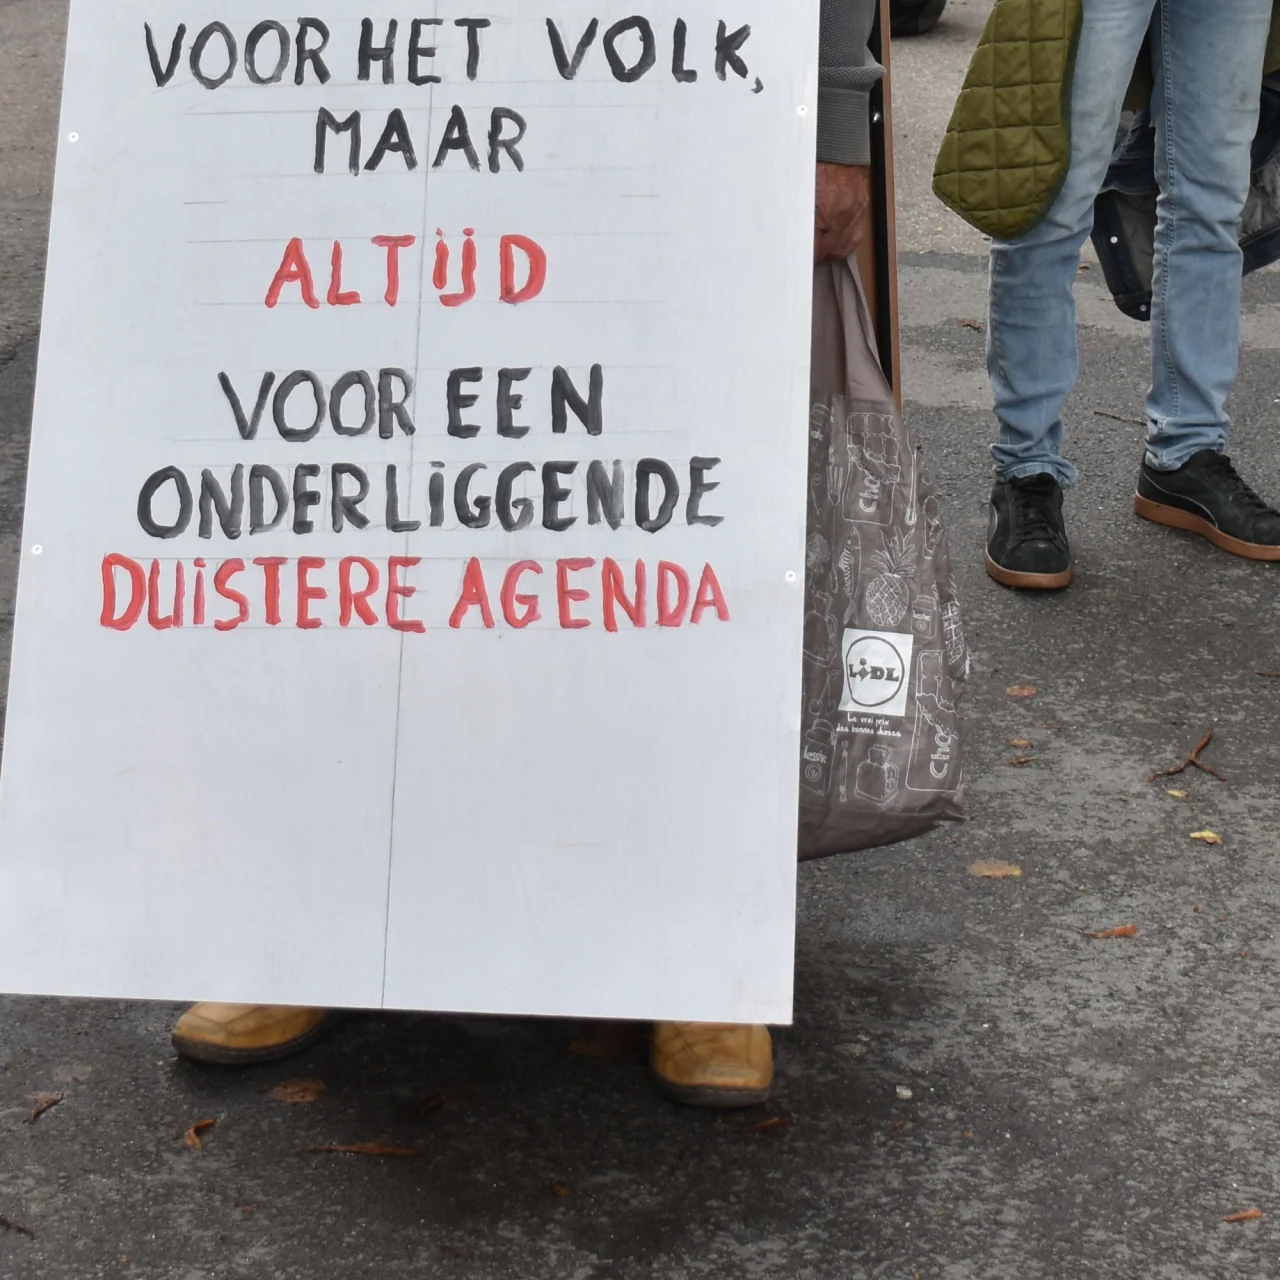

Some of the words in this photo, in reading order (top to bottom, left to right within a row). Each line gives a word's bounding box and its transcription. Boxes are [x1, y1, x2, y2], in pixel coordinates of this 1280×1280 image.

[145, 18, 332, 91] VOOR
[357, 17, 492, 88] HET
[546, 16, 765, 95] VOLK,
[314, 105, 528, 176] MAAR
[217, 368, 417, 444] VOOR
[447, 364, 605, 441] EEN
[449, 557, 732, 634] AGENDA
